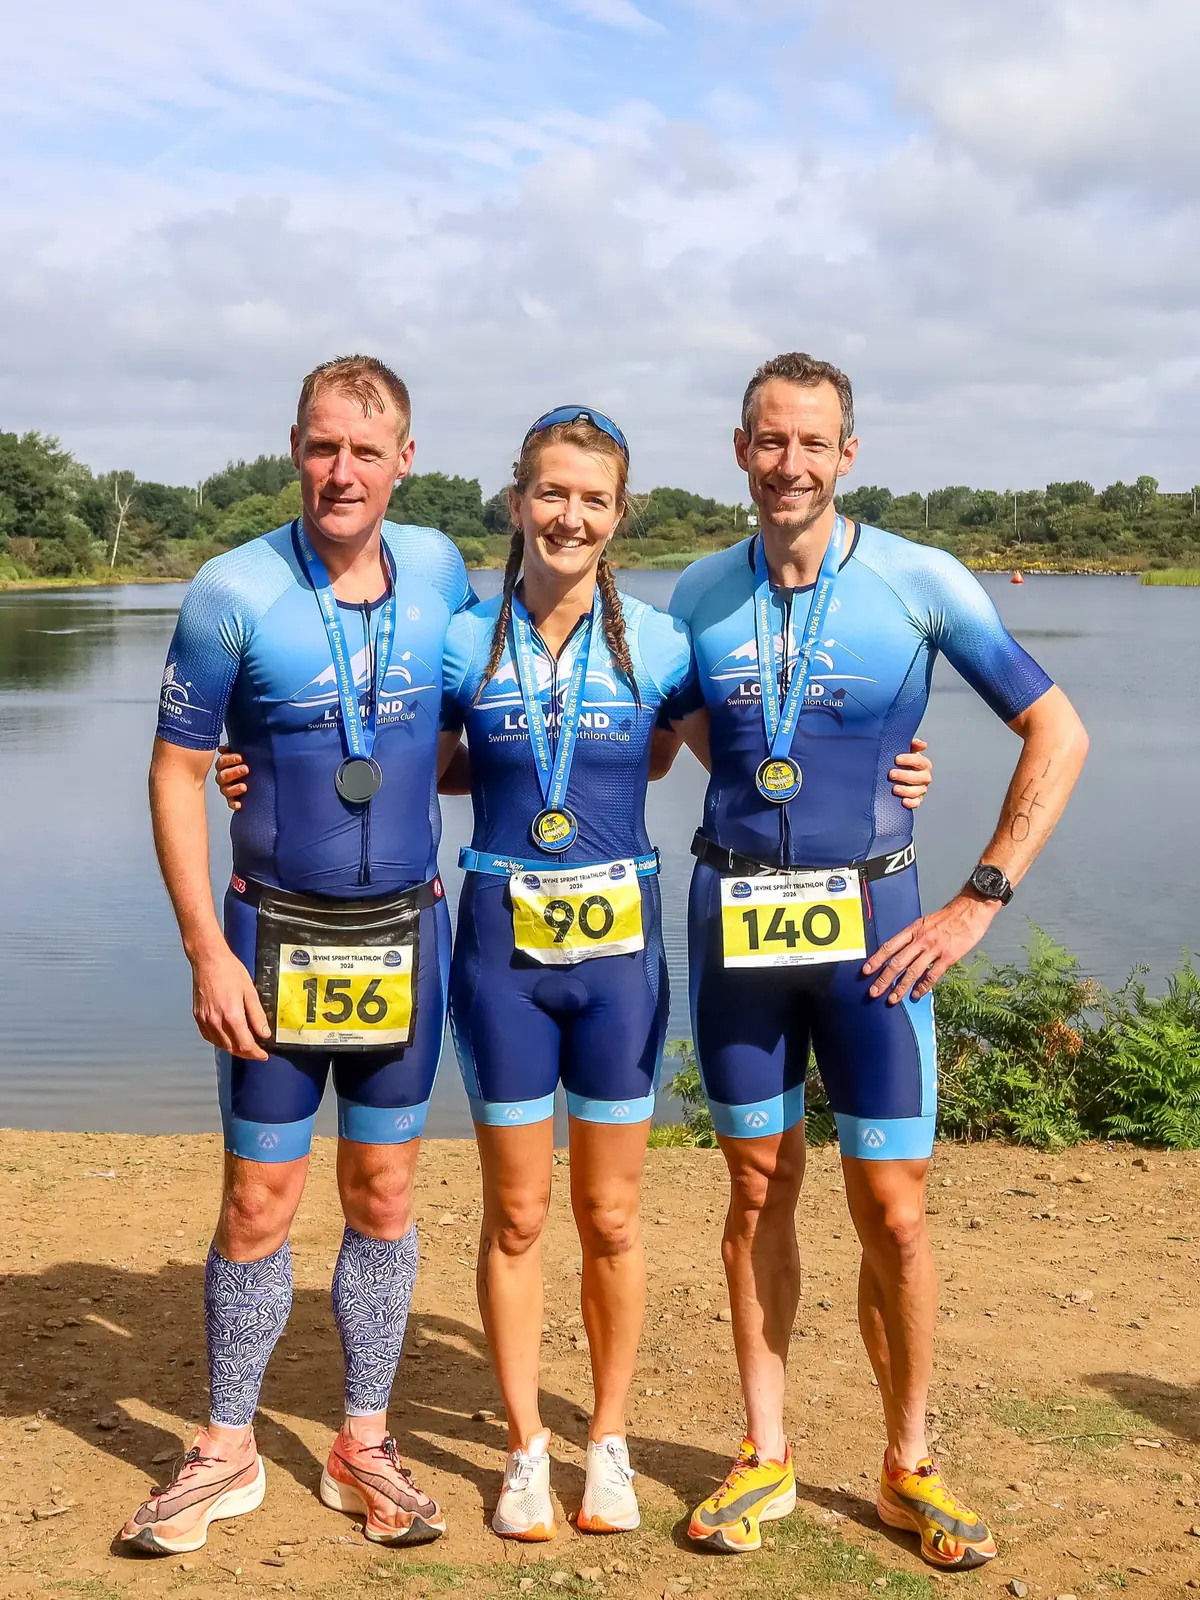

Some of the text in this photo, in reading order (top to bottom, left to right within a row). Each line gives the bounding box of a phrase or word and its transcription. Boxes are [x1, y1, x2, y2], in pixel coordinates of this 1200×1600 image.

[761, 599, 769, 632] National
[380, 605, 392, 667] Championship
[763, 633, 773, 694] Championship
[782, 698, 797, 735] National
[792, 638, 814, 697] Championship
[809, 616, 820, 636] 2026
[815, 580, 829, 614] Finisher
[322, 593, 360, 755] National Championship 2026 Finisher
[571, 663, 583, 696] Finisher
[518, 619, 548, 771] National Championship 2026 Finisher
[727, 698, 762, 706] Swimmin
[823, 699, 844, 708] Club
[740, 684, 825, 696] LOD
[161, 701, 182, 715] OND
[308, 721, 338, 730] Swimm
[376, 714, 399, 725] athlon
[400, 711, 416, 721] Club
[567, 698, 577, 718] 2026
[768, 696, 777, 716] 2026
[488, 730, 630, 743] Swimmi nd athlon Club
[556, 719, 575, 780] Championship
[551, 782, 562, 810] ational
[559, 875, 578, 883] SPRINT
[579, 871, 607, 882] TRIATHLON
[569, 882, 583, 890] 2026
[773, 883, 792, 891] SPRINT
[792, 881, 824, 890] TRIATHLON
[543, 895, 615, 943] 90
[742, 904, 841, 950] 140
[303, 977, 388, 1024] 156
